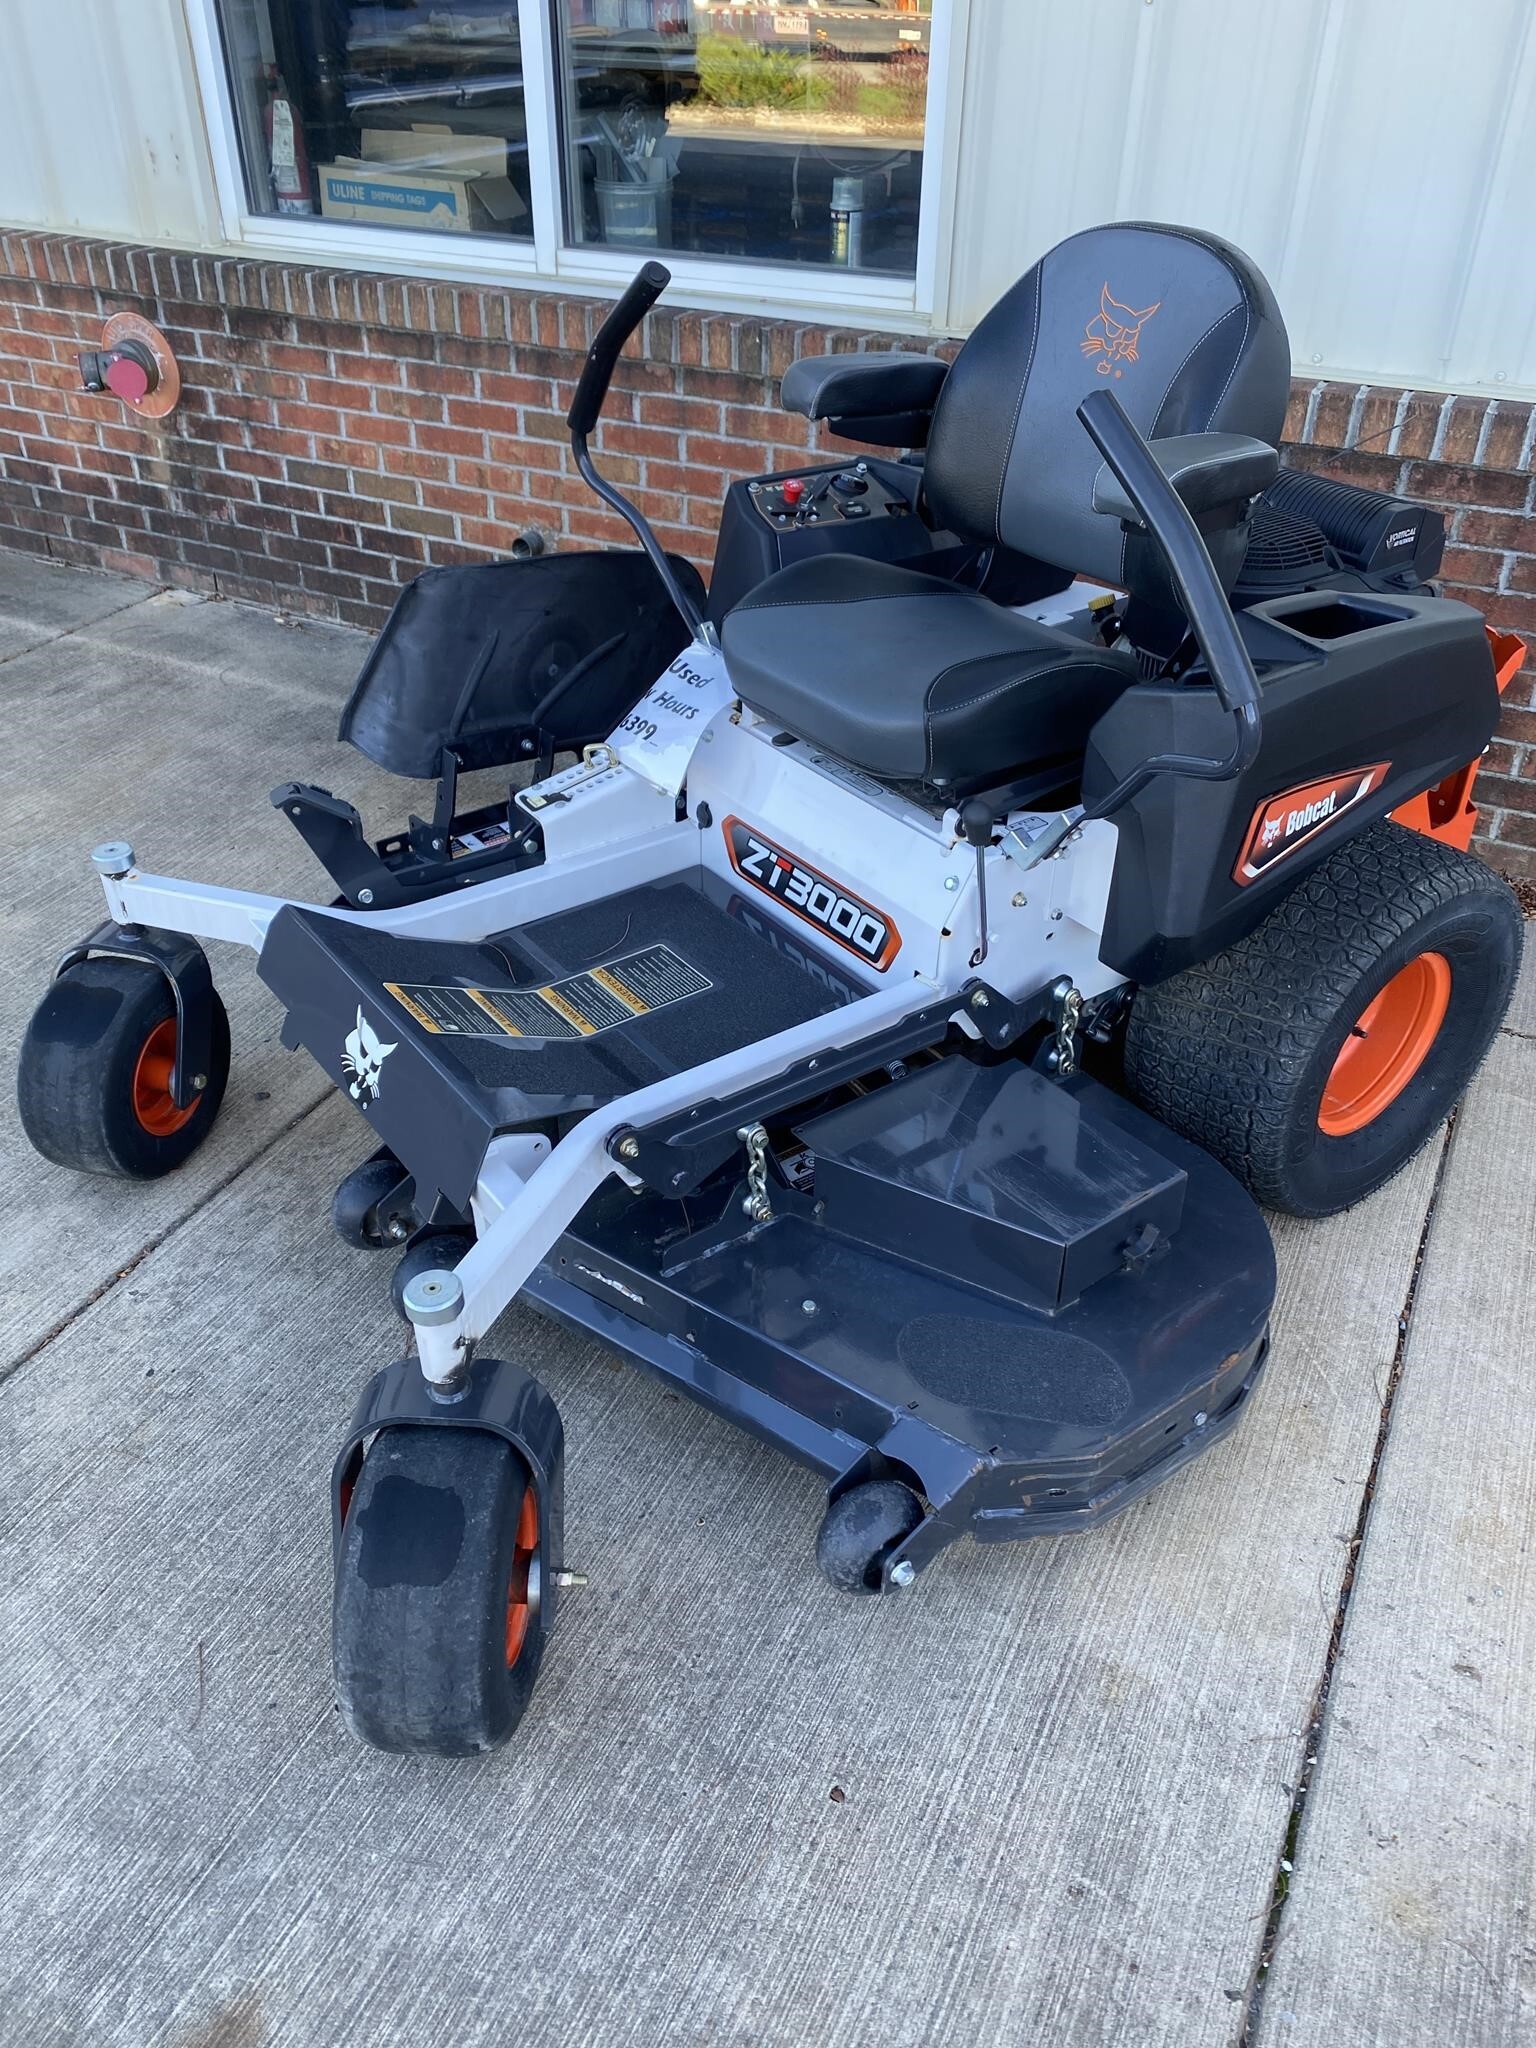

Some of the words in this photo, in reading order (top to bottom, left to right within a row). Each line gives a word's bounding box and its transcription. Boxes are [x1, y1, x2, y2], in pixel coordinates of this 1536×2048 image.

[332, 183, 365, 201] ULINE
[669, 658, 715, 688] Used
[652, 691, 699, 719] Hours
[1285, 790, 1337, 837] Bobcat
[741, 838, 886, 955] ZT3000
[597, 970, 640, 1005] ADVERTENCIA
[551, 995, 580, 1020] WARNING
